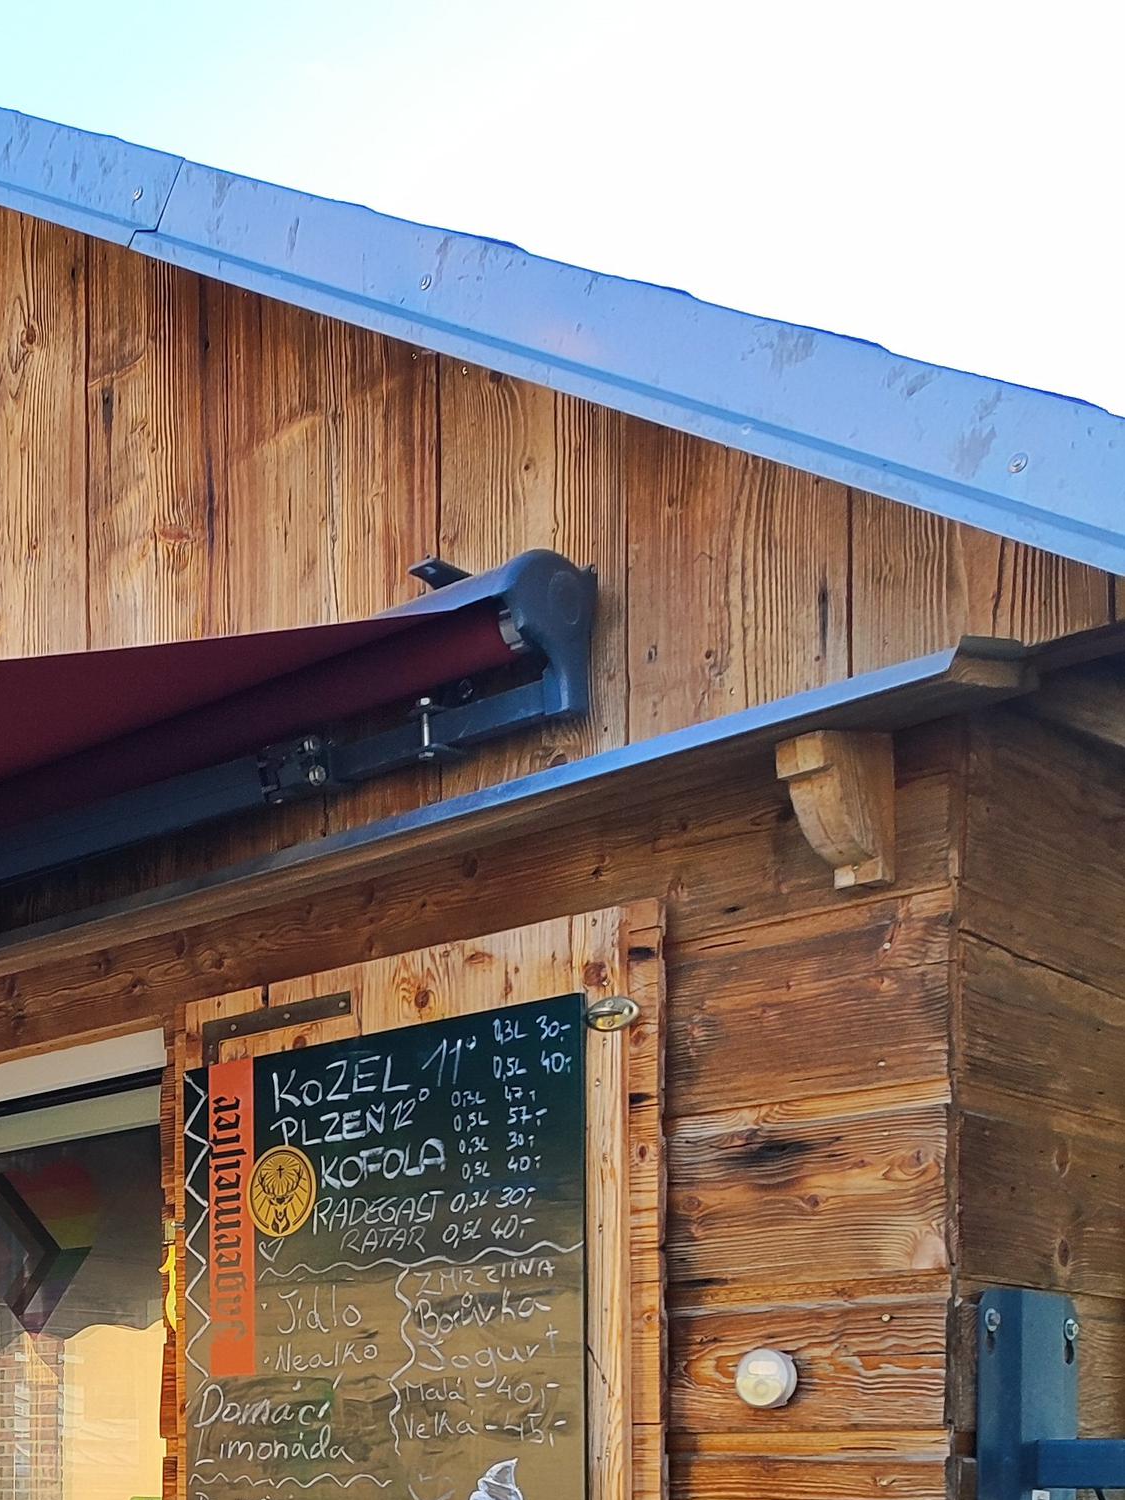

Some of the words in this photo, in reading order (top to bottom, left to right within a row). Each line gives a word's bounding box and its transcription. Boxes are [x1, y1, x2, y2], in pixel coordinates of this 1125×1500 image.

[320, 1137, 446, 1190] KOFOLA
[312, 1190, 445, 1235] RADEGAST
[340, 1225, 426, 1255] RATAR
[277, 1285, 362, 1334] Jídlo
[418, 1323, 559, 1388] Jogurt
[405, 1377, 466, 1402] Malá
[194, 1424, 355, 1467] Limonáda
